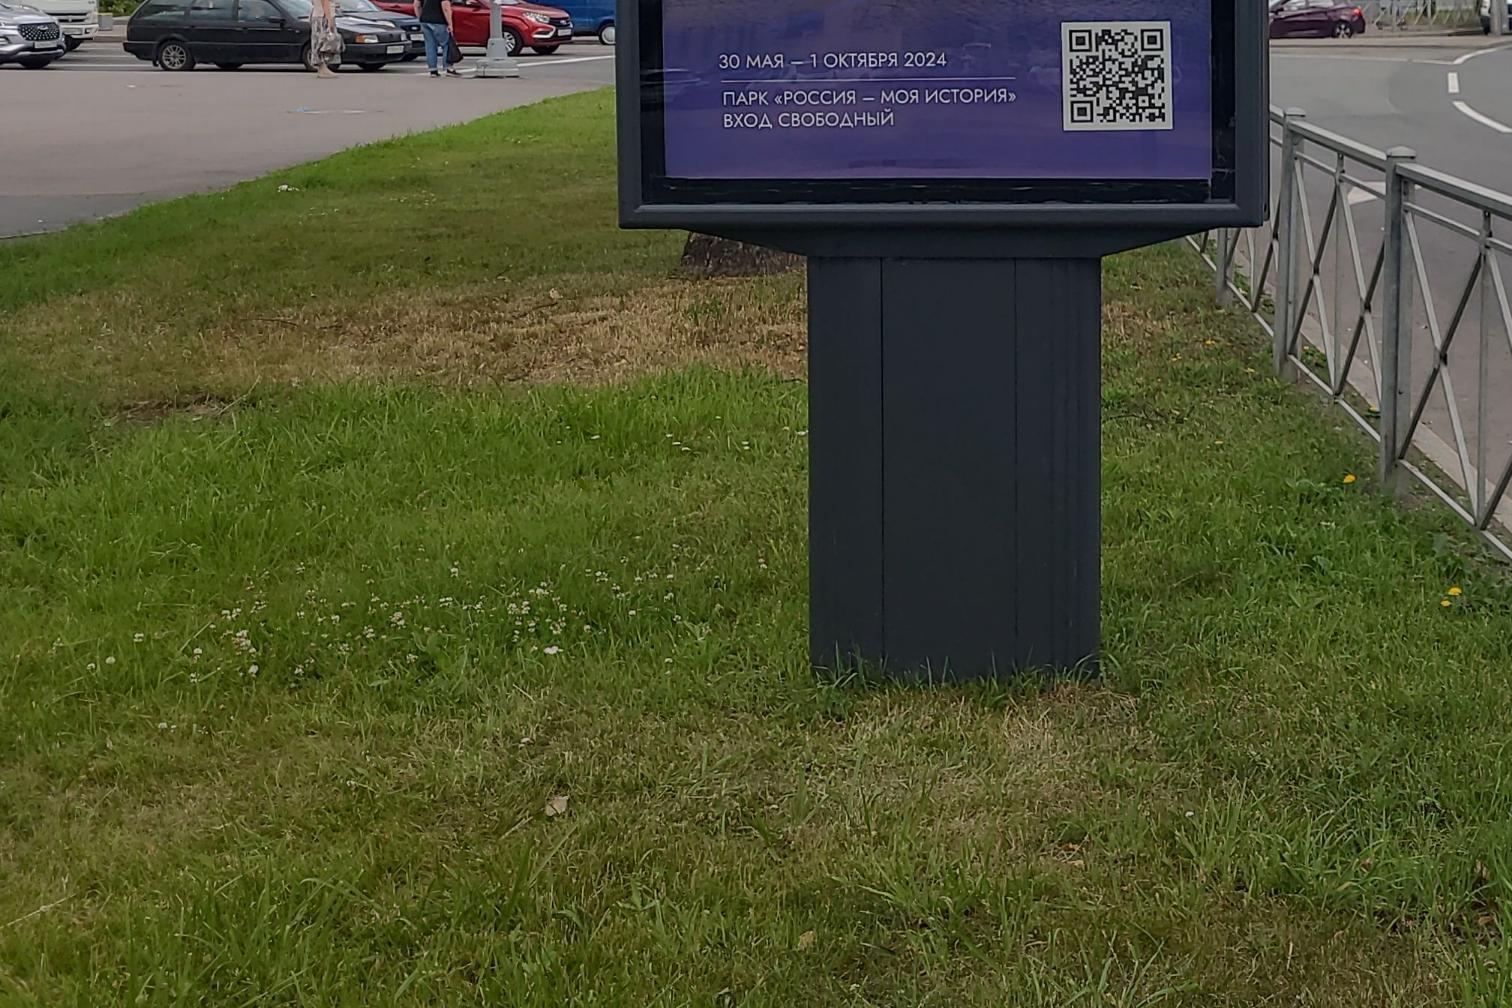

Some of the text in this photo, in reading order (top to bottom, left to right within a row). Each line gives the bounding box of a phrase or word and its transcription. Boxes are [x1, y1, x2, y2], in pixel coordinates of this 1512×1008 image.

[719, 54, 740, 69] 30
[746, 54, 784, 69] МАЯ
[810, 53, 817, 68] 1
[823, 53, 898, 68] ОКТЯБРЯ
[904, 52, 947, 67] 2024
[723, 91, 769, 106] ПАРК
[774, 90, 856, 105] «РОССИЯ
[881, 89, 919, 104] МОЯ
[925, 88, 1017, 104] ИСТОРИЯ»
[723, 108, 894, 129] ВХОД СВОБОДНЫЙ
